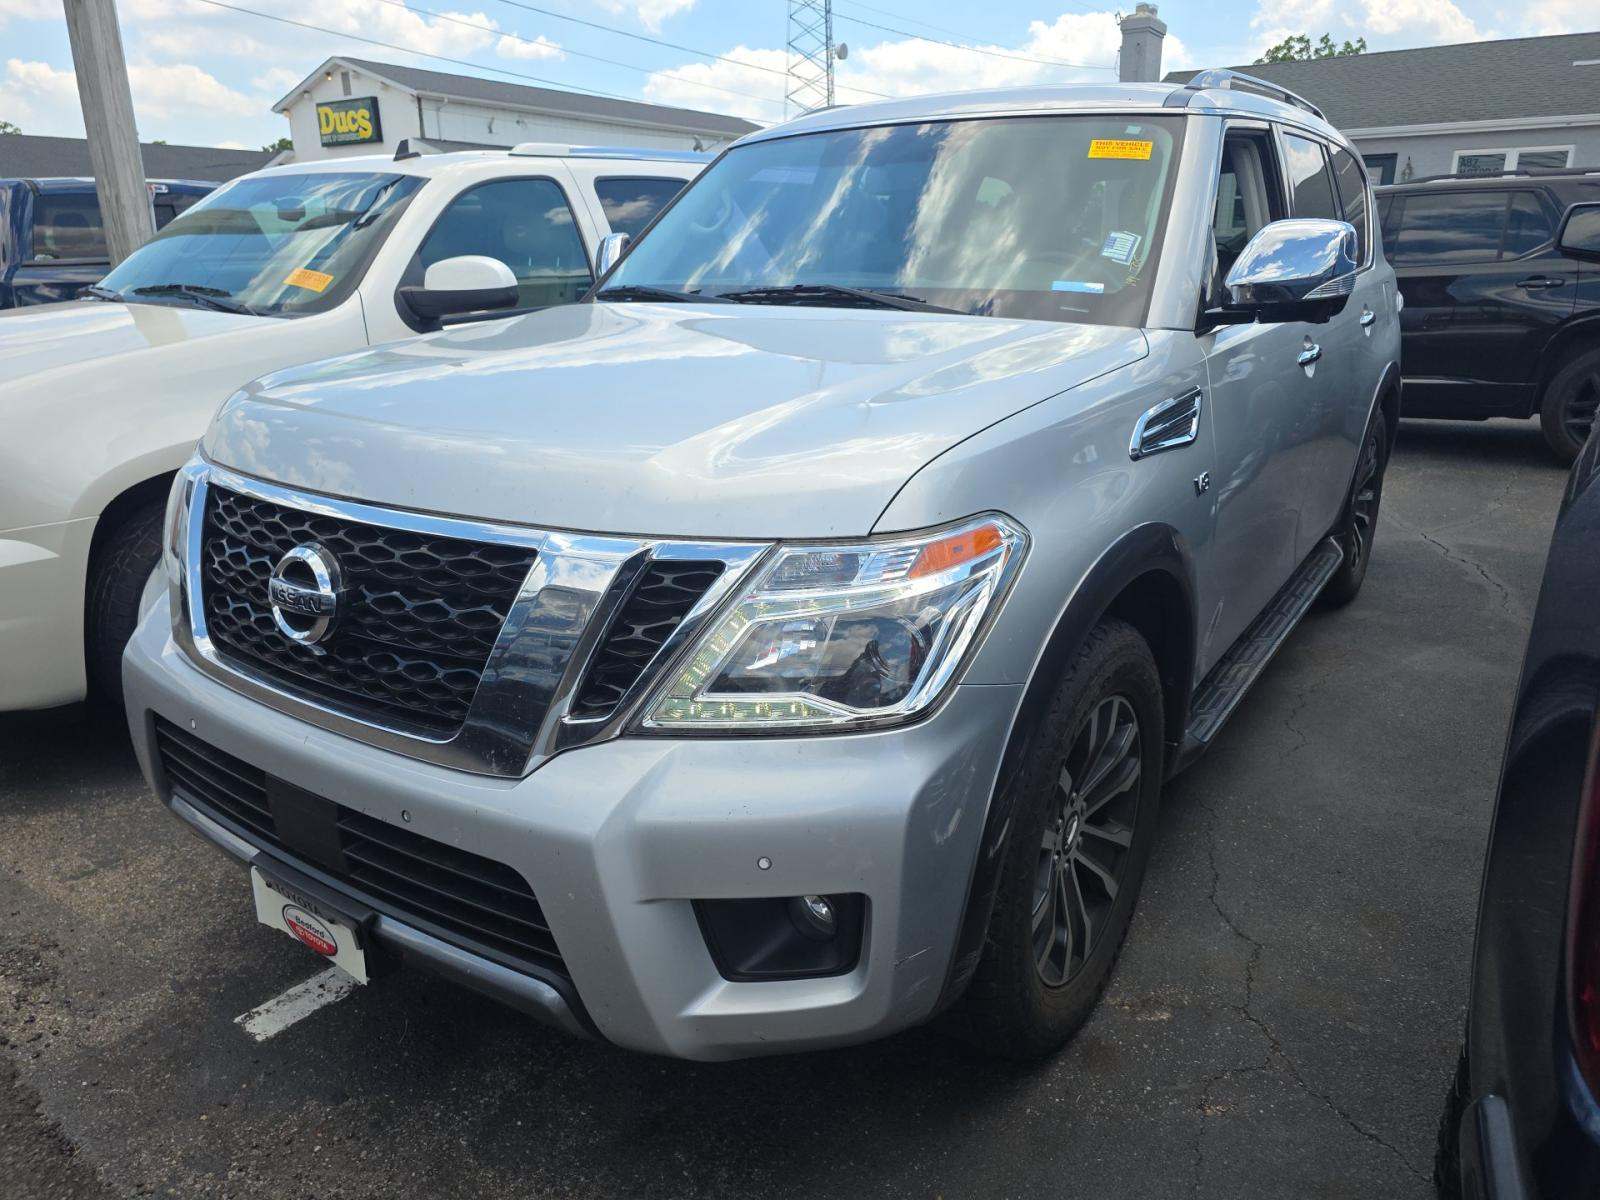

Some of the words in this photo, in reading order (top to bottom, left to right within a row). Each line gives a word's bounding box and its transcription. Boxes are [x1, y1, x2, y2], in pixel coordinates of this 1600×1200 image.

[1193, 471, 1210, 498] V8
[272, 583, 321, 613] NISSAN
[295, 916, 325, 938] Bedford
[303, 930, 328, 950] TOYOTA
